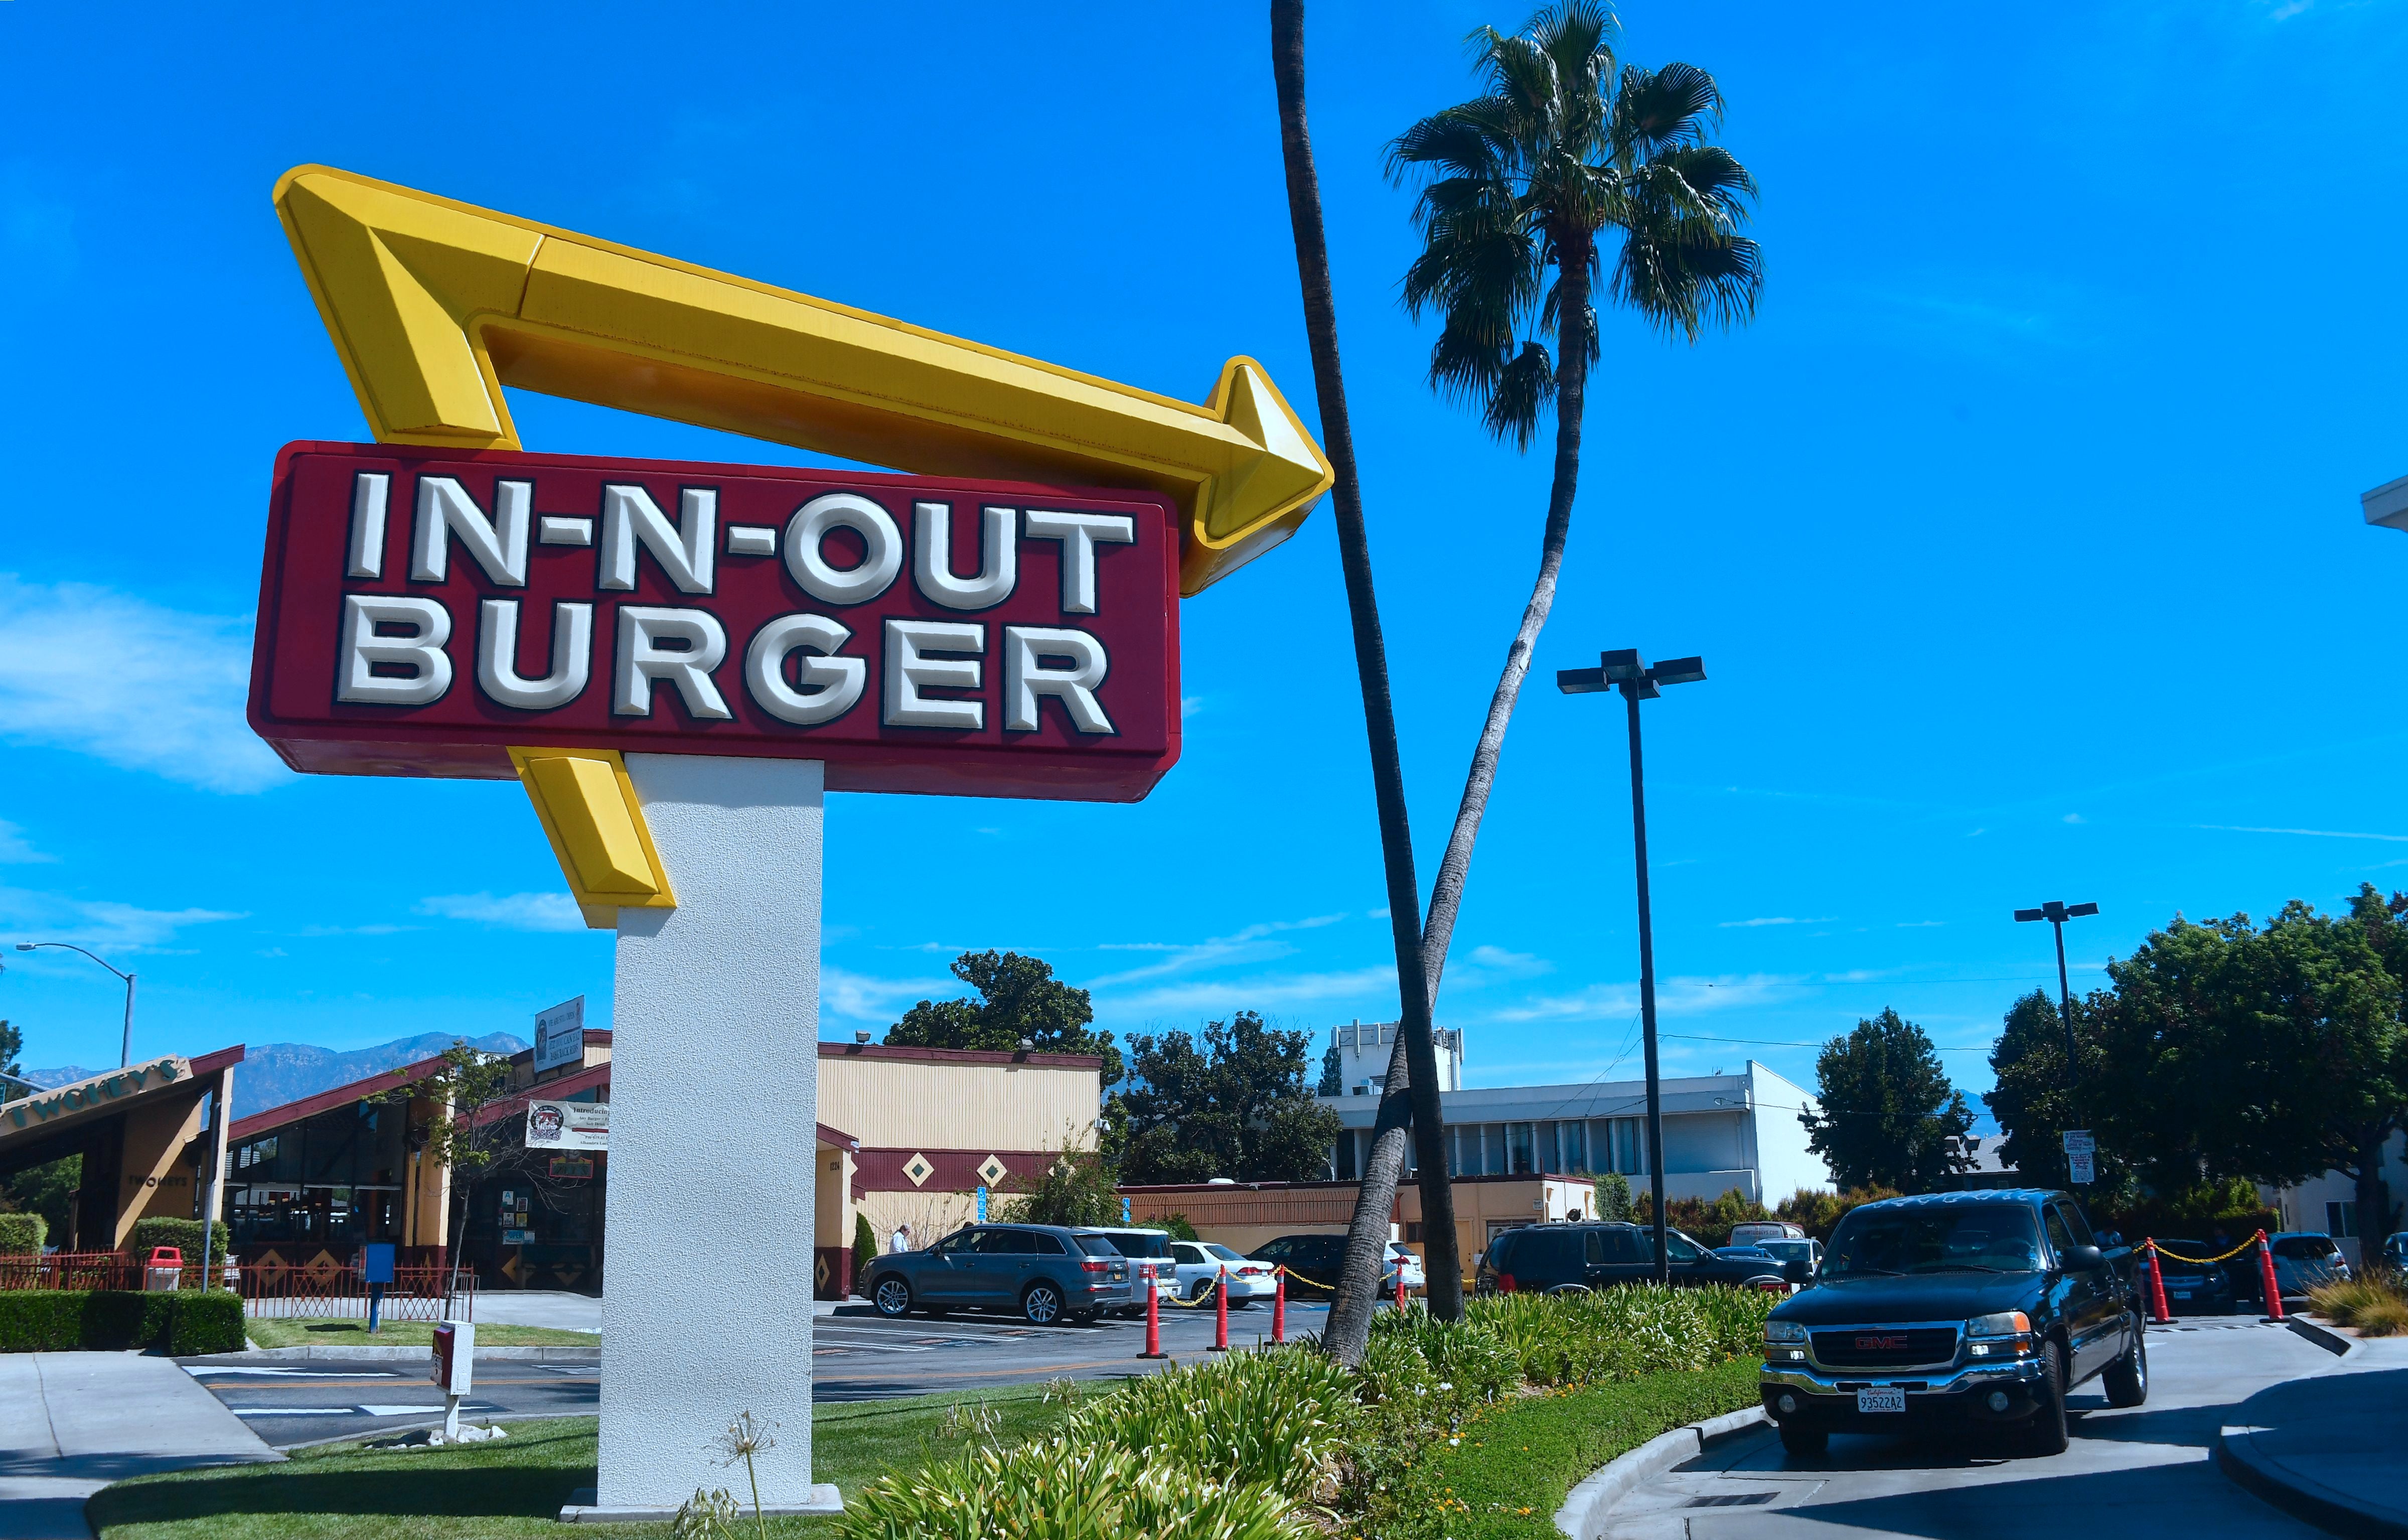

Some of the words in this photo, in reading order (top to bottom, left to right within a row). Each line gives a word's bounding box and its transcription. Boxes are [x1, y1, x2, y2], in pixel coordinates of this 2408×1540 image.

[348, 473, 1134, 614] IN-N-OUT
[338, 594, 1116, 735] BURGER
[563, 1034, 572, 1045] CAN
[560, 1048, 569, 1058] BACK
[7, 1059, 179, 1128] TWOHEY'S
[830, 1161, 839, 1171] 1224
[1856, 1337, 1908, 1349] GMC
[1861, 1396, 1902, 1410] 93522A2
